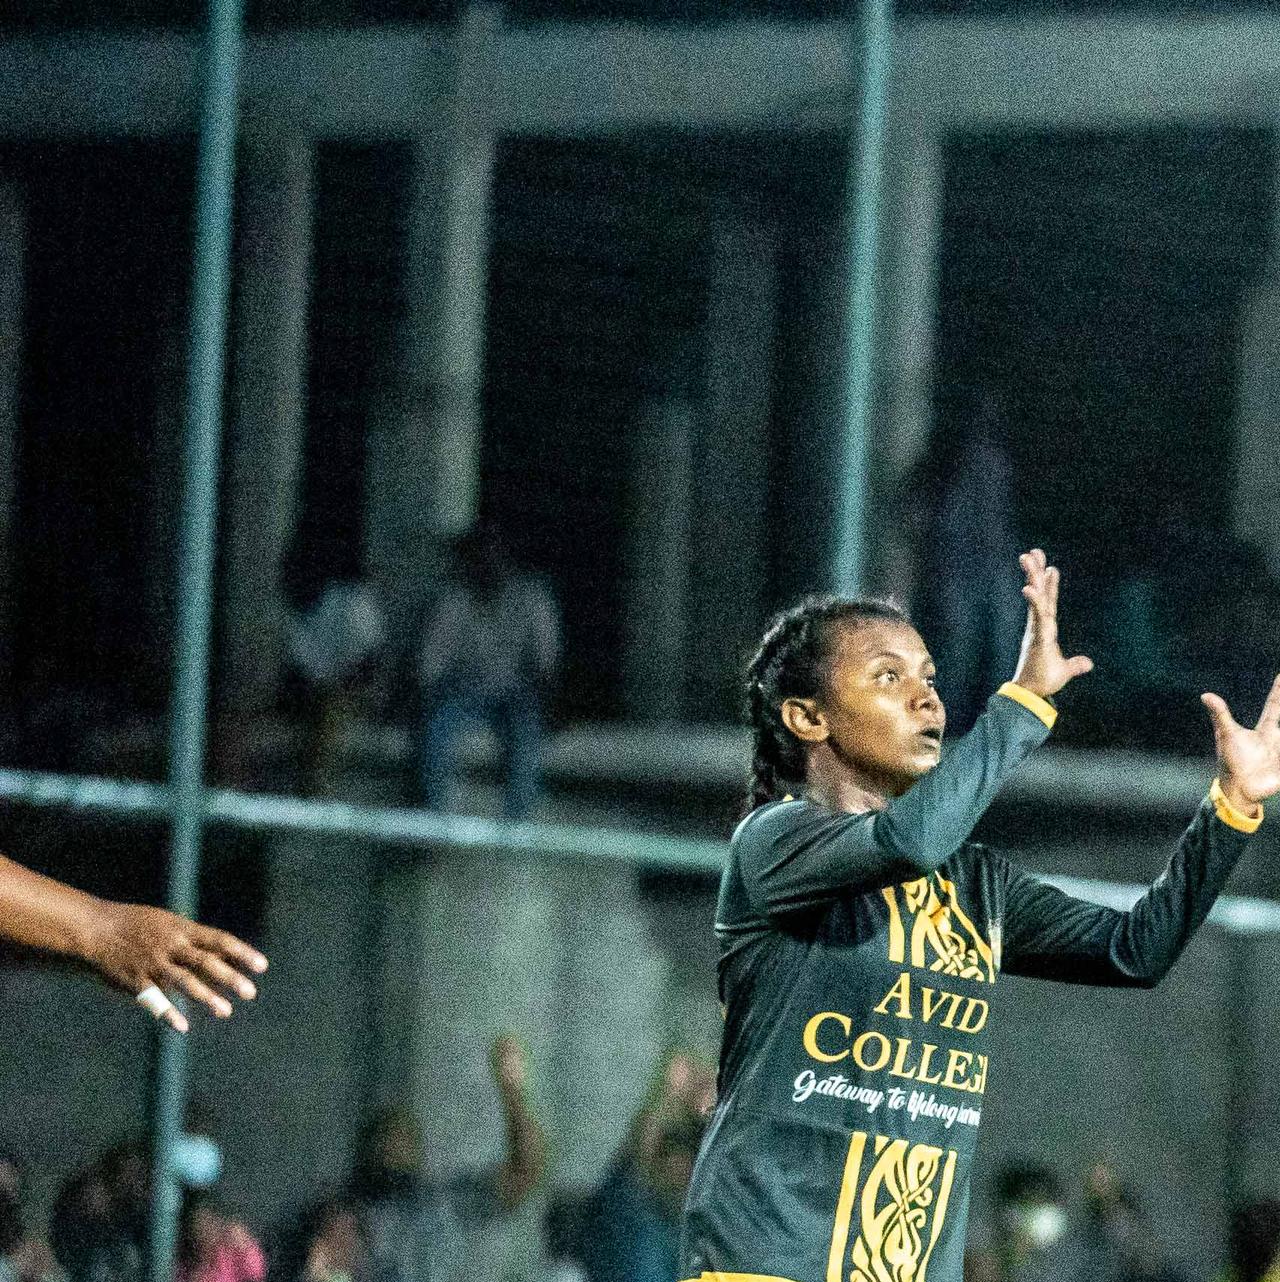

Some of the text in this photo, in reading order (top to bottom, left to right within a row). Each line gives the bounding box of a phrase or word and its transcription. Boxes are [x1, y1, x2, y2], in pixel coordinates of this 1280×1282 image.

[873, 972, 989, 1034] AVID
[792, 1069, 885, 1113] Gateway
[886, 1086, 906, 1110] to
